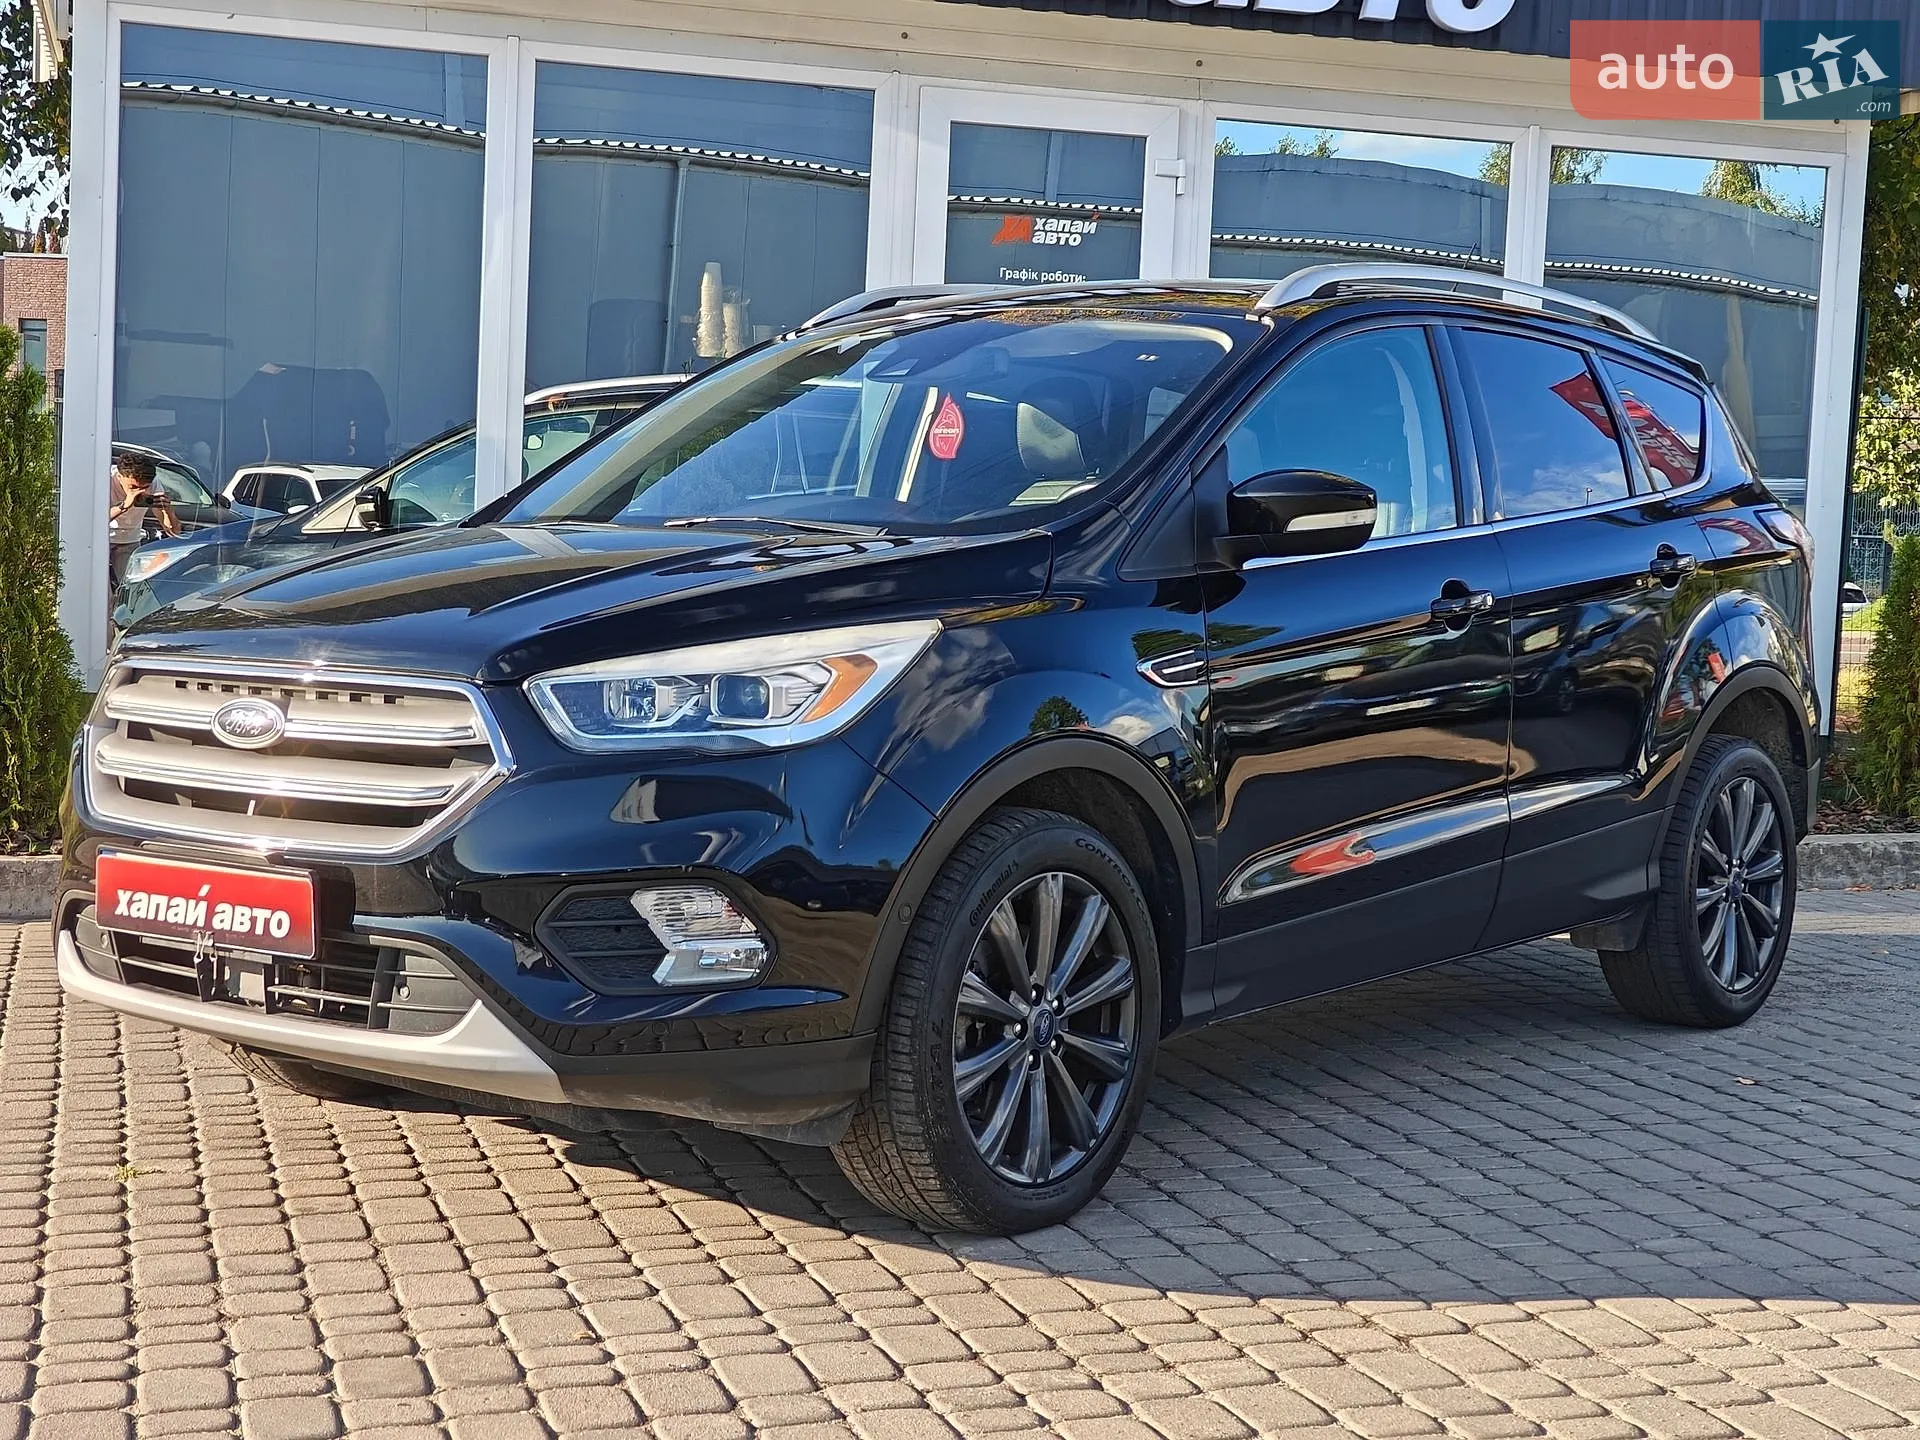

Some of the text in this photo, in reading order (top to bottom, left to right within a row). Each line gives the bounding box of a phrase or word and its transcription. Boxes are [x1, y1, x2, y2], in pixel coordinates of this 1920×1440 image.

[1031, 231, 1082, 247] авто
[1000, 267, 1087, 283] Графік роботи:
[212, 902, 291, 939] авто
